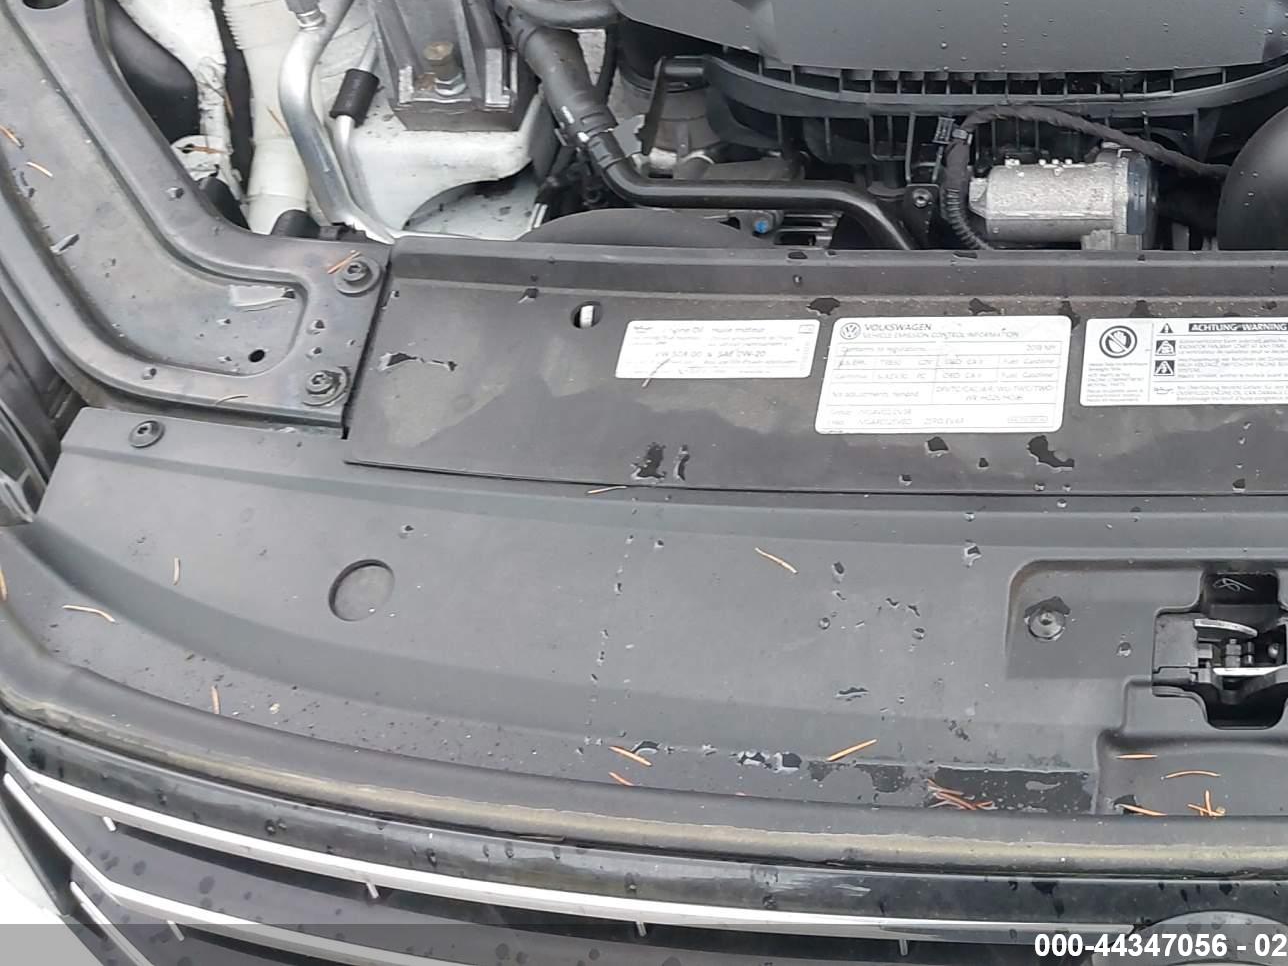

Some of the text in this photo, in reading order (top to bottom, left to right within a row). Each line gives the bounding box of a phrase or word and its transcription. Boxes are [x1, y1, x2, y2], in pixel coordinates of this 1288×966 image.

[864, 323, 932, 331] VOLKSWAGEN
[1191, 322, 1238, 332] ACHTUNG
[1242, 322, 1288, 331] WARNING
